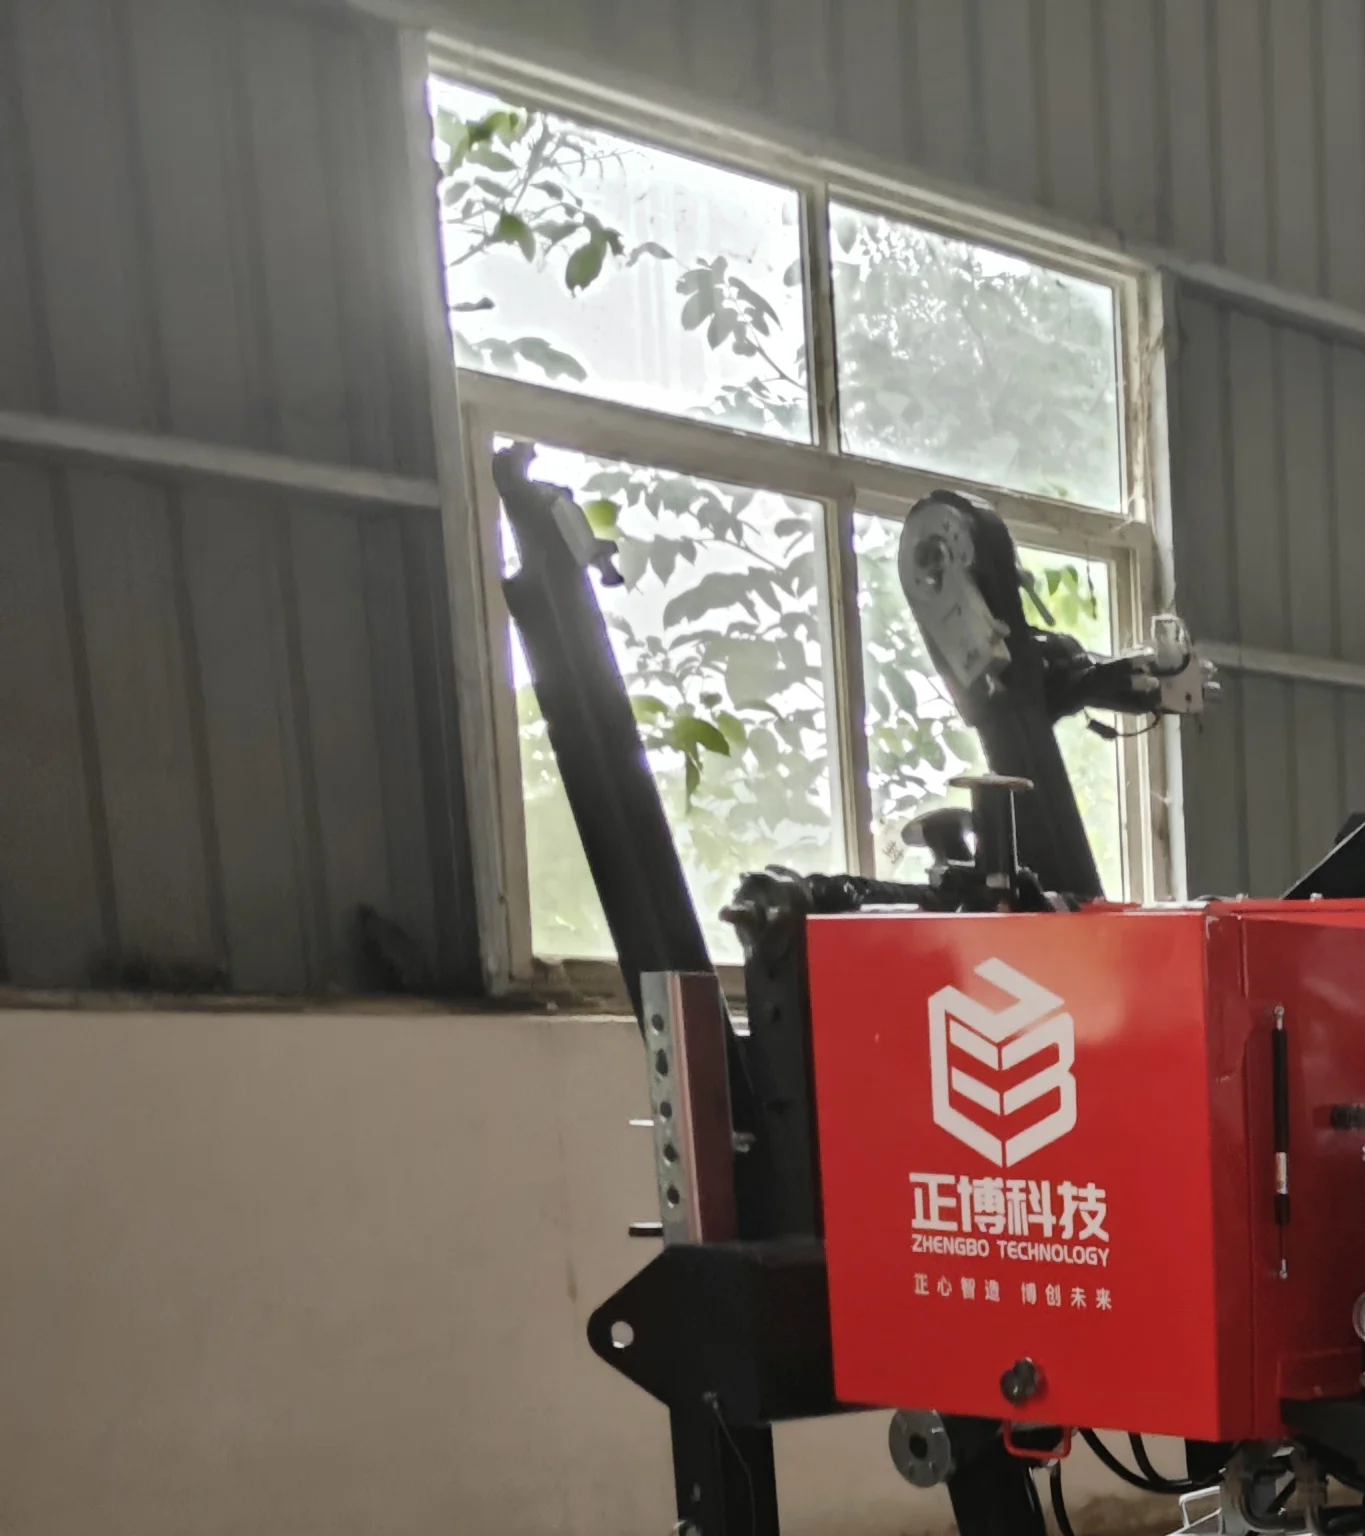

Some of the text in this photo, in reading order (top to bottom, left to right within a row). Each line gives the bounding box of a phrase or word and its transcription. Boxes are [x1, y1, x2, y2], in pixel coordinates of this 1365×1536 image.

[909, 1172, 1110, 1243] 正博科技
[911, 1234, 1110, 1267] ZHENGBO TECHNOLOGY
